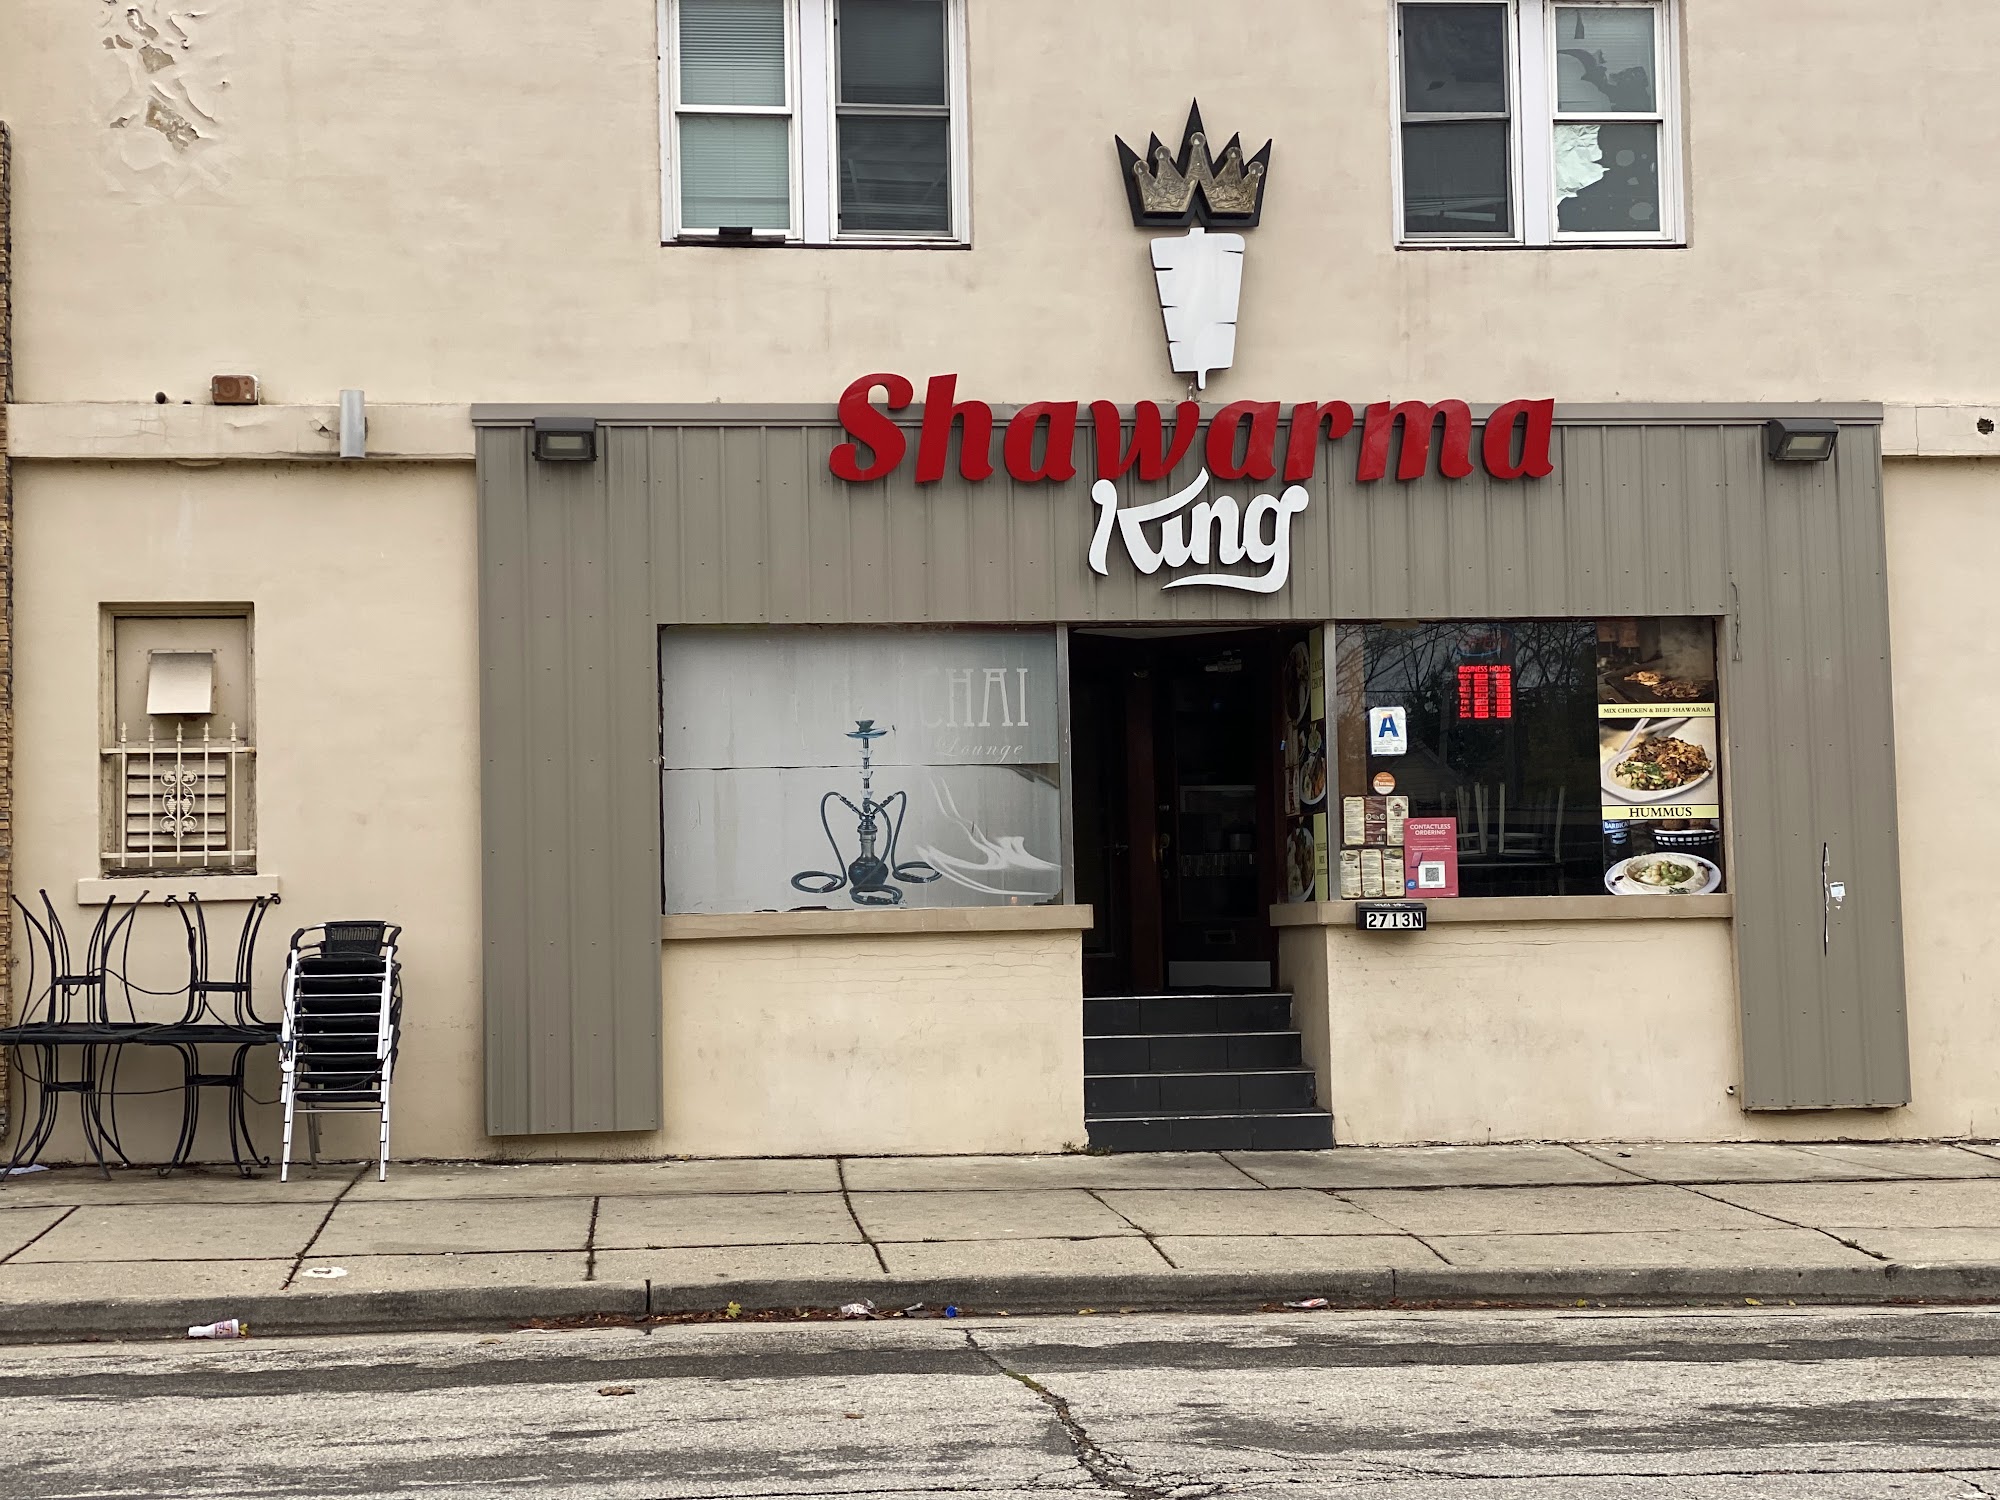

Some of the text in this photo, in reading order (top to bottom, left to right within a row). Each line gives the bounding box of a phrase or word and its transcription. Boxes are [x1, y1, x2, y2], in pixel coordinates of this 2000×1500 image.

[829, 373, 1554, 483] Shawarma
[1087, 467, 1309, 594] King
[1458, 665, 1512, 673] BUSINESS HOURS
[1378, 713, 1399, 737] A
[937, 736, 1024, 763] Lounge
[1629, 807, 1692, 817] HUMMUS
[1368, 912, 1422, 928] 2713N
